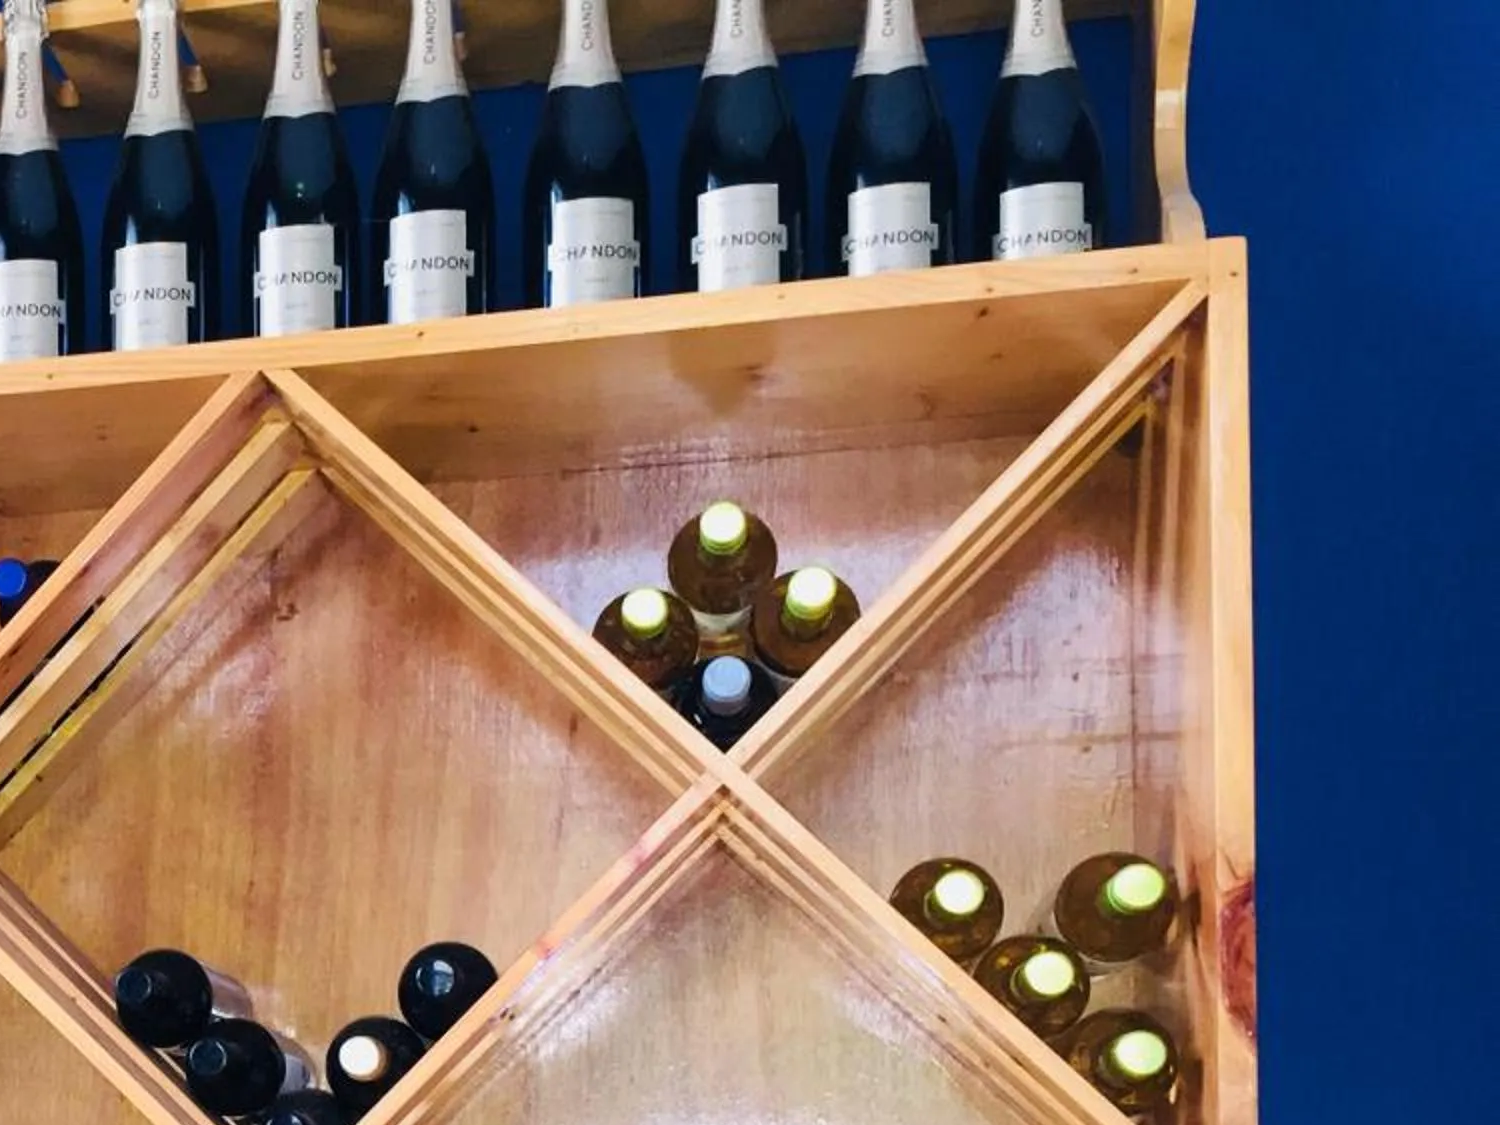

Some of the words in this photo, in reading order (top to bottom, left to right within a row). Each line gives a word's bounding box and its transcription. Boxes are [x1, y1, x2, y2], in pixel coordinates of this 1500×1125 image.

[292, 10, 306, 81] CHANDON
[423, 0, 437, 65] CHANDO
[147, 30, 163, 100] CHANDON
[15, 50, 28, 119] CHANDON
[694, 231, 783, 256] CANDON
[844, 228, 934, 255] CHANDON
[998, 229, 1087, 254] CHANDON
[386, 254, 470, 280] CANDON
[113, 287, 191, 308] CANDON
